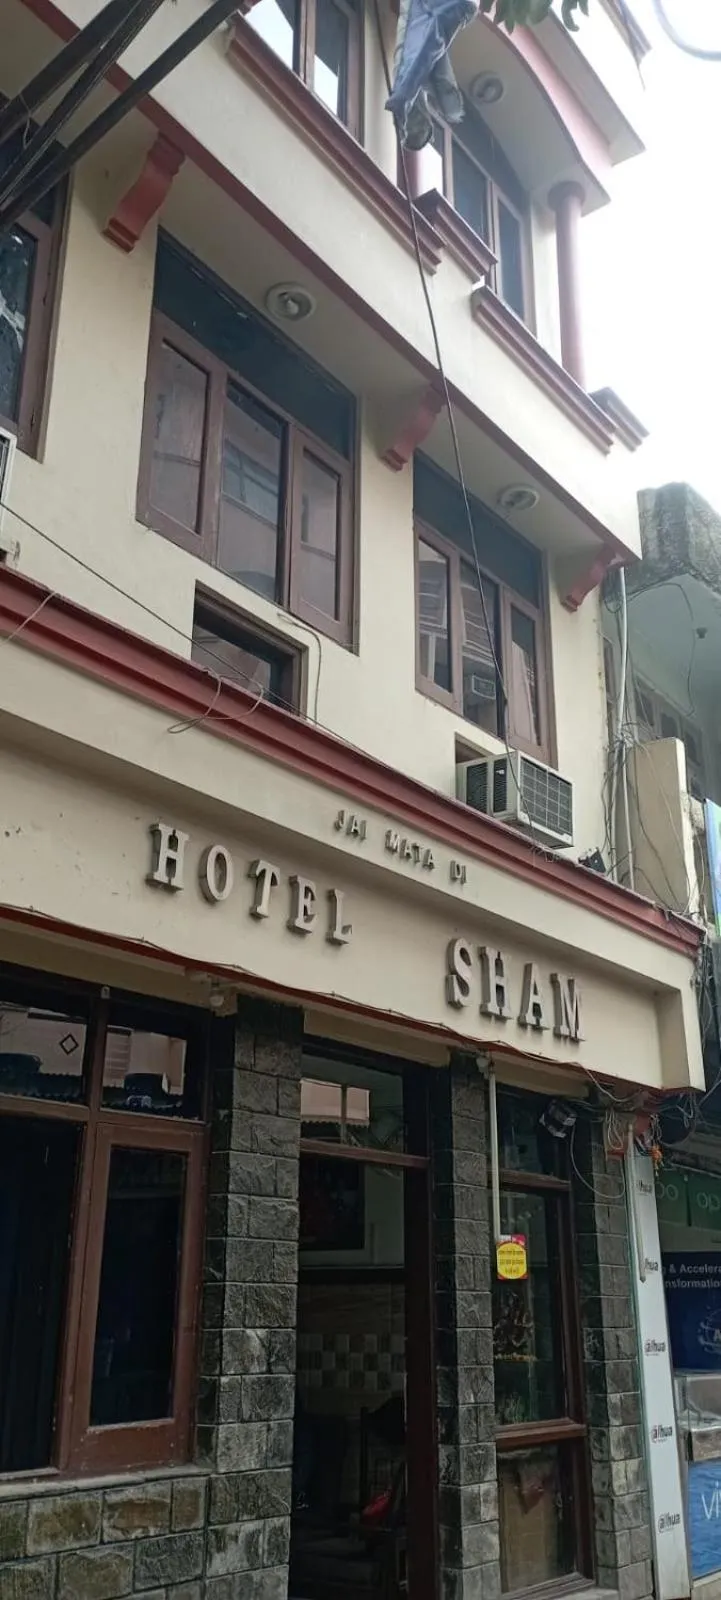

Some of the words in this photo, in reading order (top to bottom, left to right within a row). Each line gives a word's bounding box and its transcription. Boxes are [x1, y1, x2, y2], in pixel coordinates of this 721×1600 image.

[334, 810, 367, 841] JAI
[385, 829, 435, 871] MATA
[449, 860, 466, 885] DI
[146, 822, 353, 946] HOTEL
[446, 937, 586, 1042] SHAM
